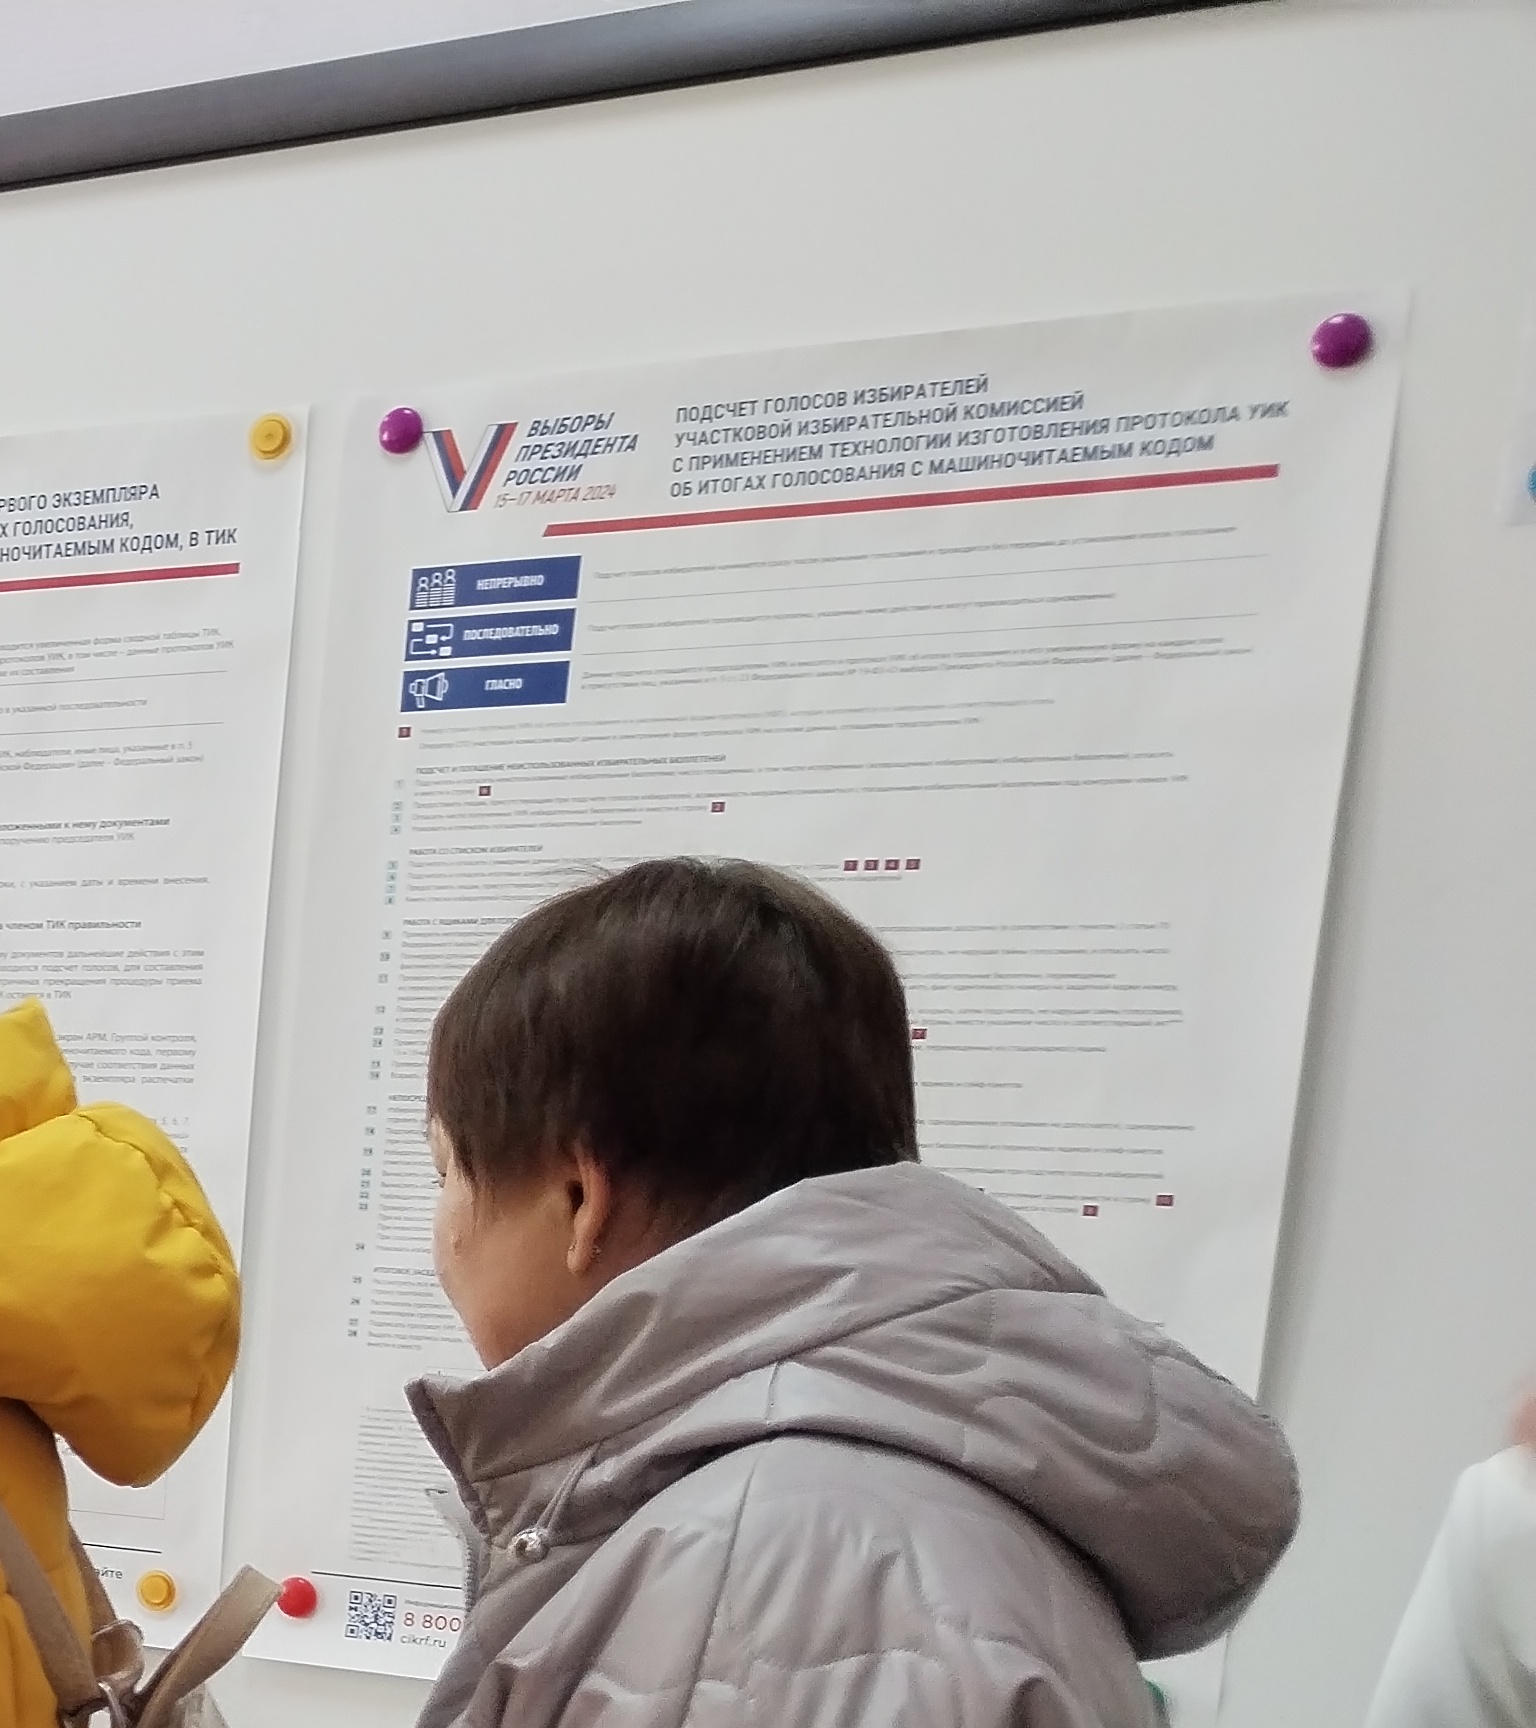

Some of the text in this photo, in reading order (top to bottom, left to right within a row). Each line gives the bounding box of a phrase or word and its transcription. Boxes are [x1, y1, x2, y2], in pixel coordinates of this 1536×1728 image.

[675, 373, 989, 424] ПОДСЧЕТ ГОЛОСОВ ИЗБИРАТЕЛЕЙ
[527, 412, 615, 438] ВЫБОРЫ
[675, 390, 1085, 448] УЧАСТКОВОЙ ИЗБИРАТЕЛЬНОЙ КОМИССИЕЙ
[514, 434, 639, 462] ПРЕЗИДЕНТА
[672, 399, 1290, 473] С ПРИМЕНЕНИЕМ ТЕХНОЛОГИИ ИЗГОТОВЛЕНИЯ ПРОТОКОЛА УИК
[503, 464, 583, 487] РОССИИ
[670, 433, 1215, 497] ОБ ИТОГАХ ГОЛОСОВАНИЯ С МАШИНОЧИТАЕМЫМ КОДОМ
[52, 484, 160, 509] ЭКЗЕМПЛЯРА
[533, 487, 580, 505] МАРТА
[581, 483, 616, 501] 2024
[13, 511, 134, 537] ГОЛОСОВАНИЯ,
[119, 533, 183, 554] КОДОМ,
[189, 531, 199, 547] В
[205, 528, 238, 546] ТИК
[476, 574, 545, 591] НЕПРЕРЫВНО
[463, 624, 560, 641] ПОСЛЕДОВАТЕЛЬНО
[484, 678, 523, 691] ГЛАСНО
[403, 1612, 462, 1632] 8 800
[400, 1635, 447, 1648] cikrf.ru
